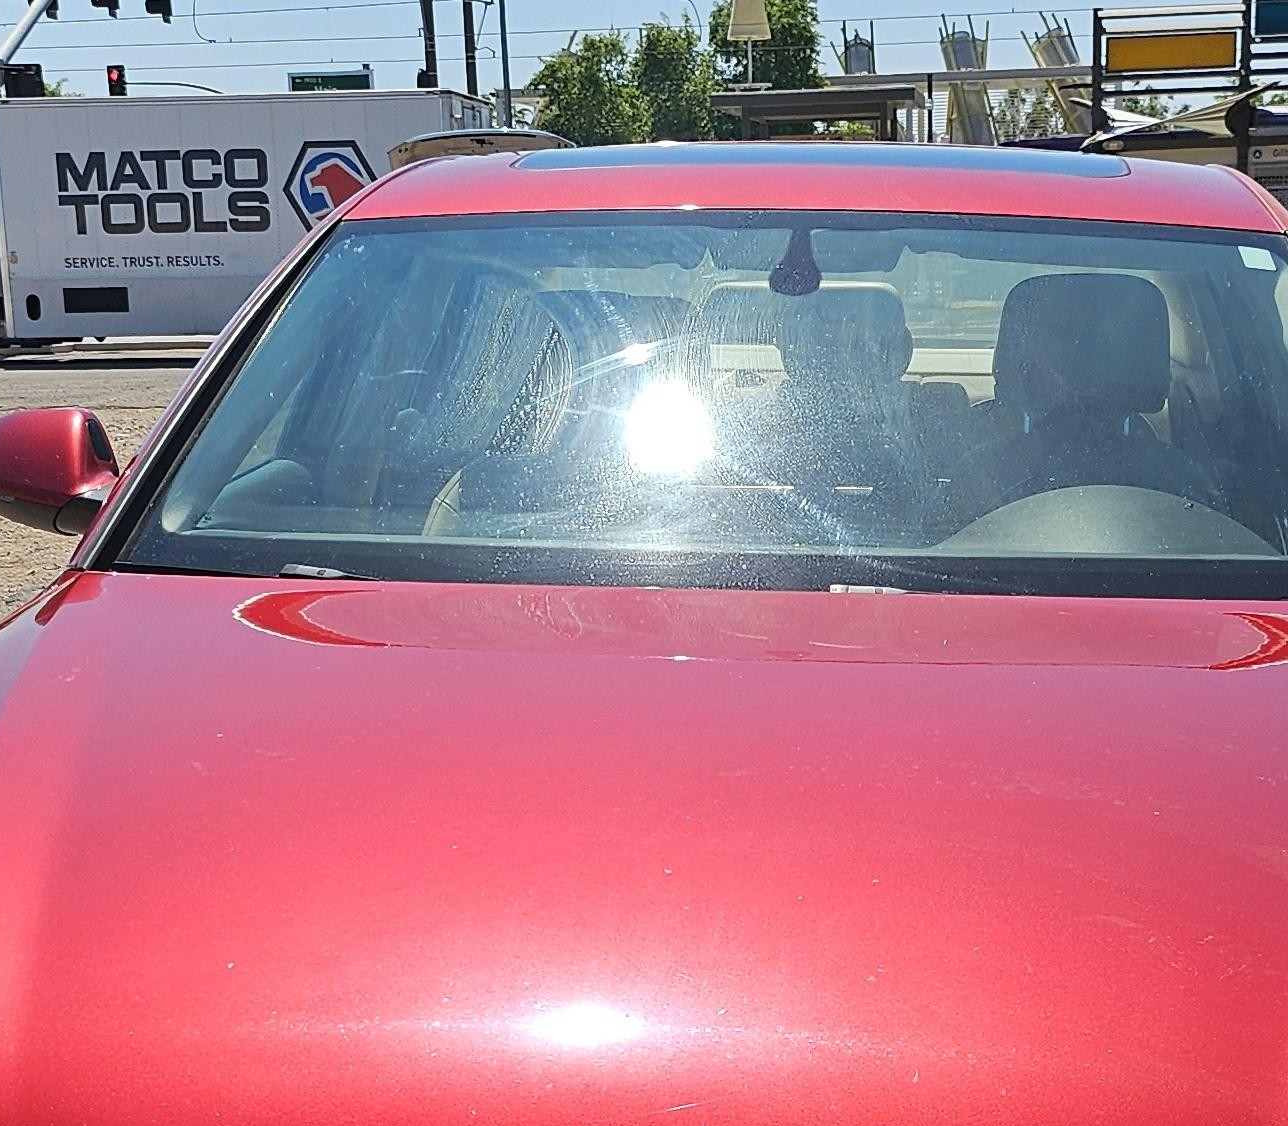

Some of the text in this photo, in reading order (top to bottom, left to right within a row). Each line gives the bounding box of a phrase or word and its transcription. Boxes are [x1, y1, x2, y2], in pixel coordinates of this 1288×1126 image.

[55, 148, 269, 192] MATCO
[58, 190, 271, 235] TOOLS
[64, 255, 225, 269] SERVICE. TRUST. RESULTS.
